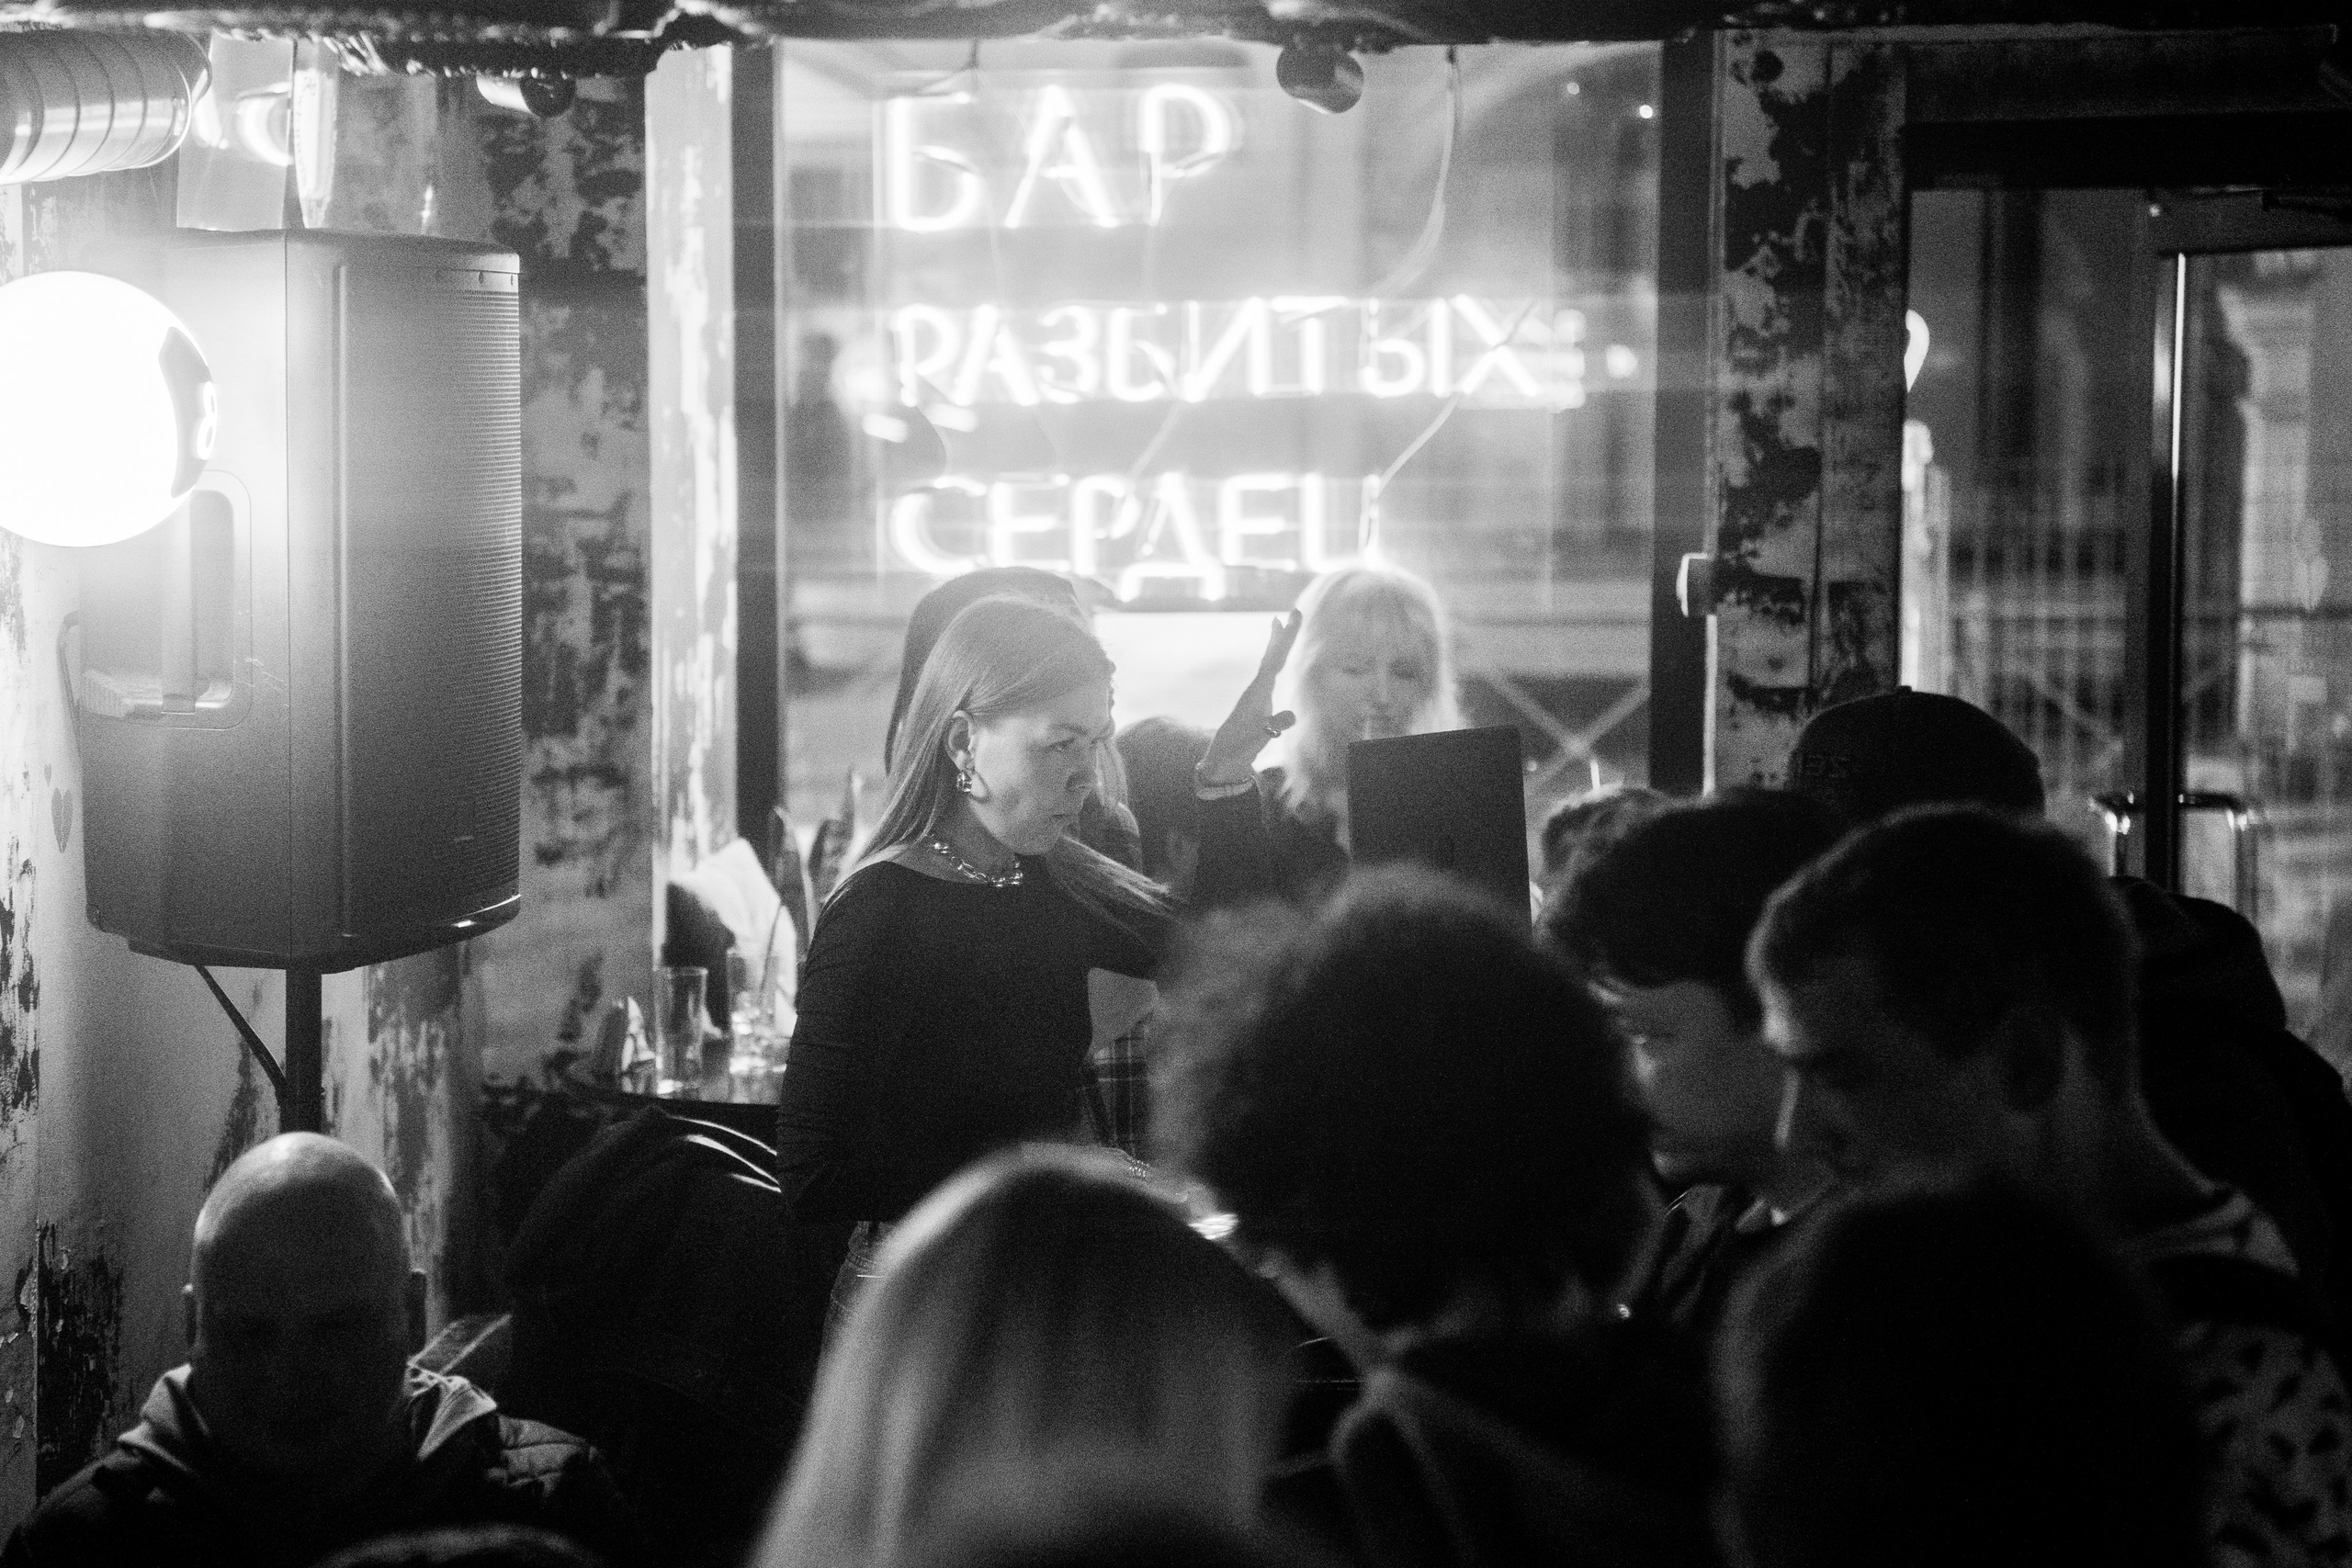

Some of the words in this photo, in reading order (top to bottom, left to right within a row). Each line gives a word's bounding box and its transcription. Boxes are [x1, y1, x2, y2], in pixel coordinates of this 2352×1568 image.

[888, 82, 1233, 233] БАР
[894, 295, 1545, 406] РАЗБИТЫХ
[893, 471, 1385, 602] СЕРДЕЦ
